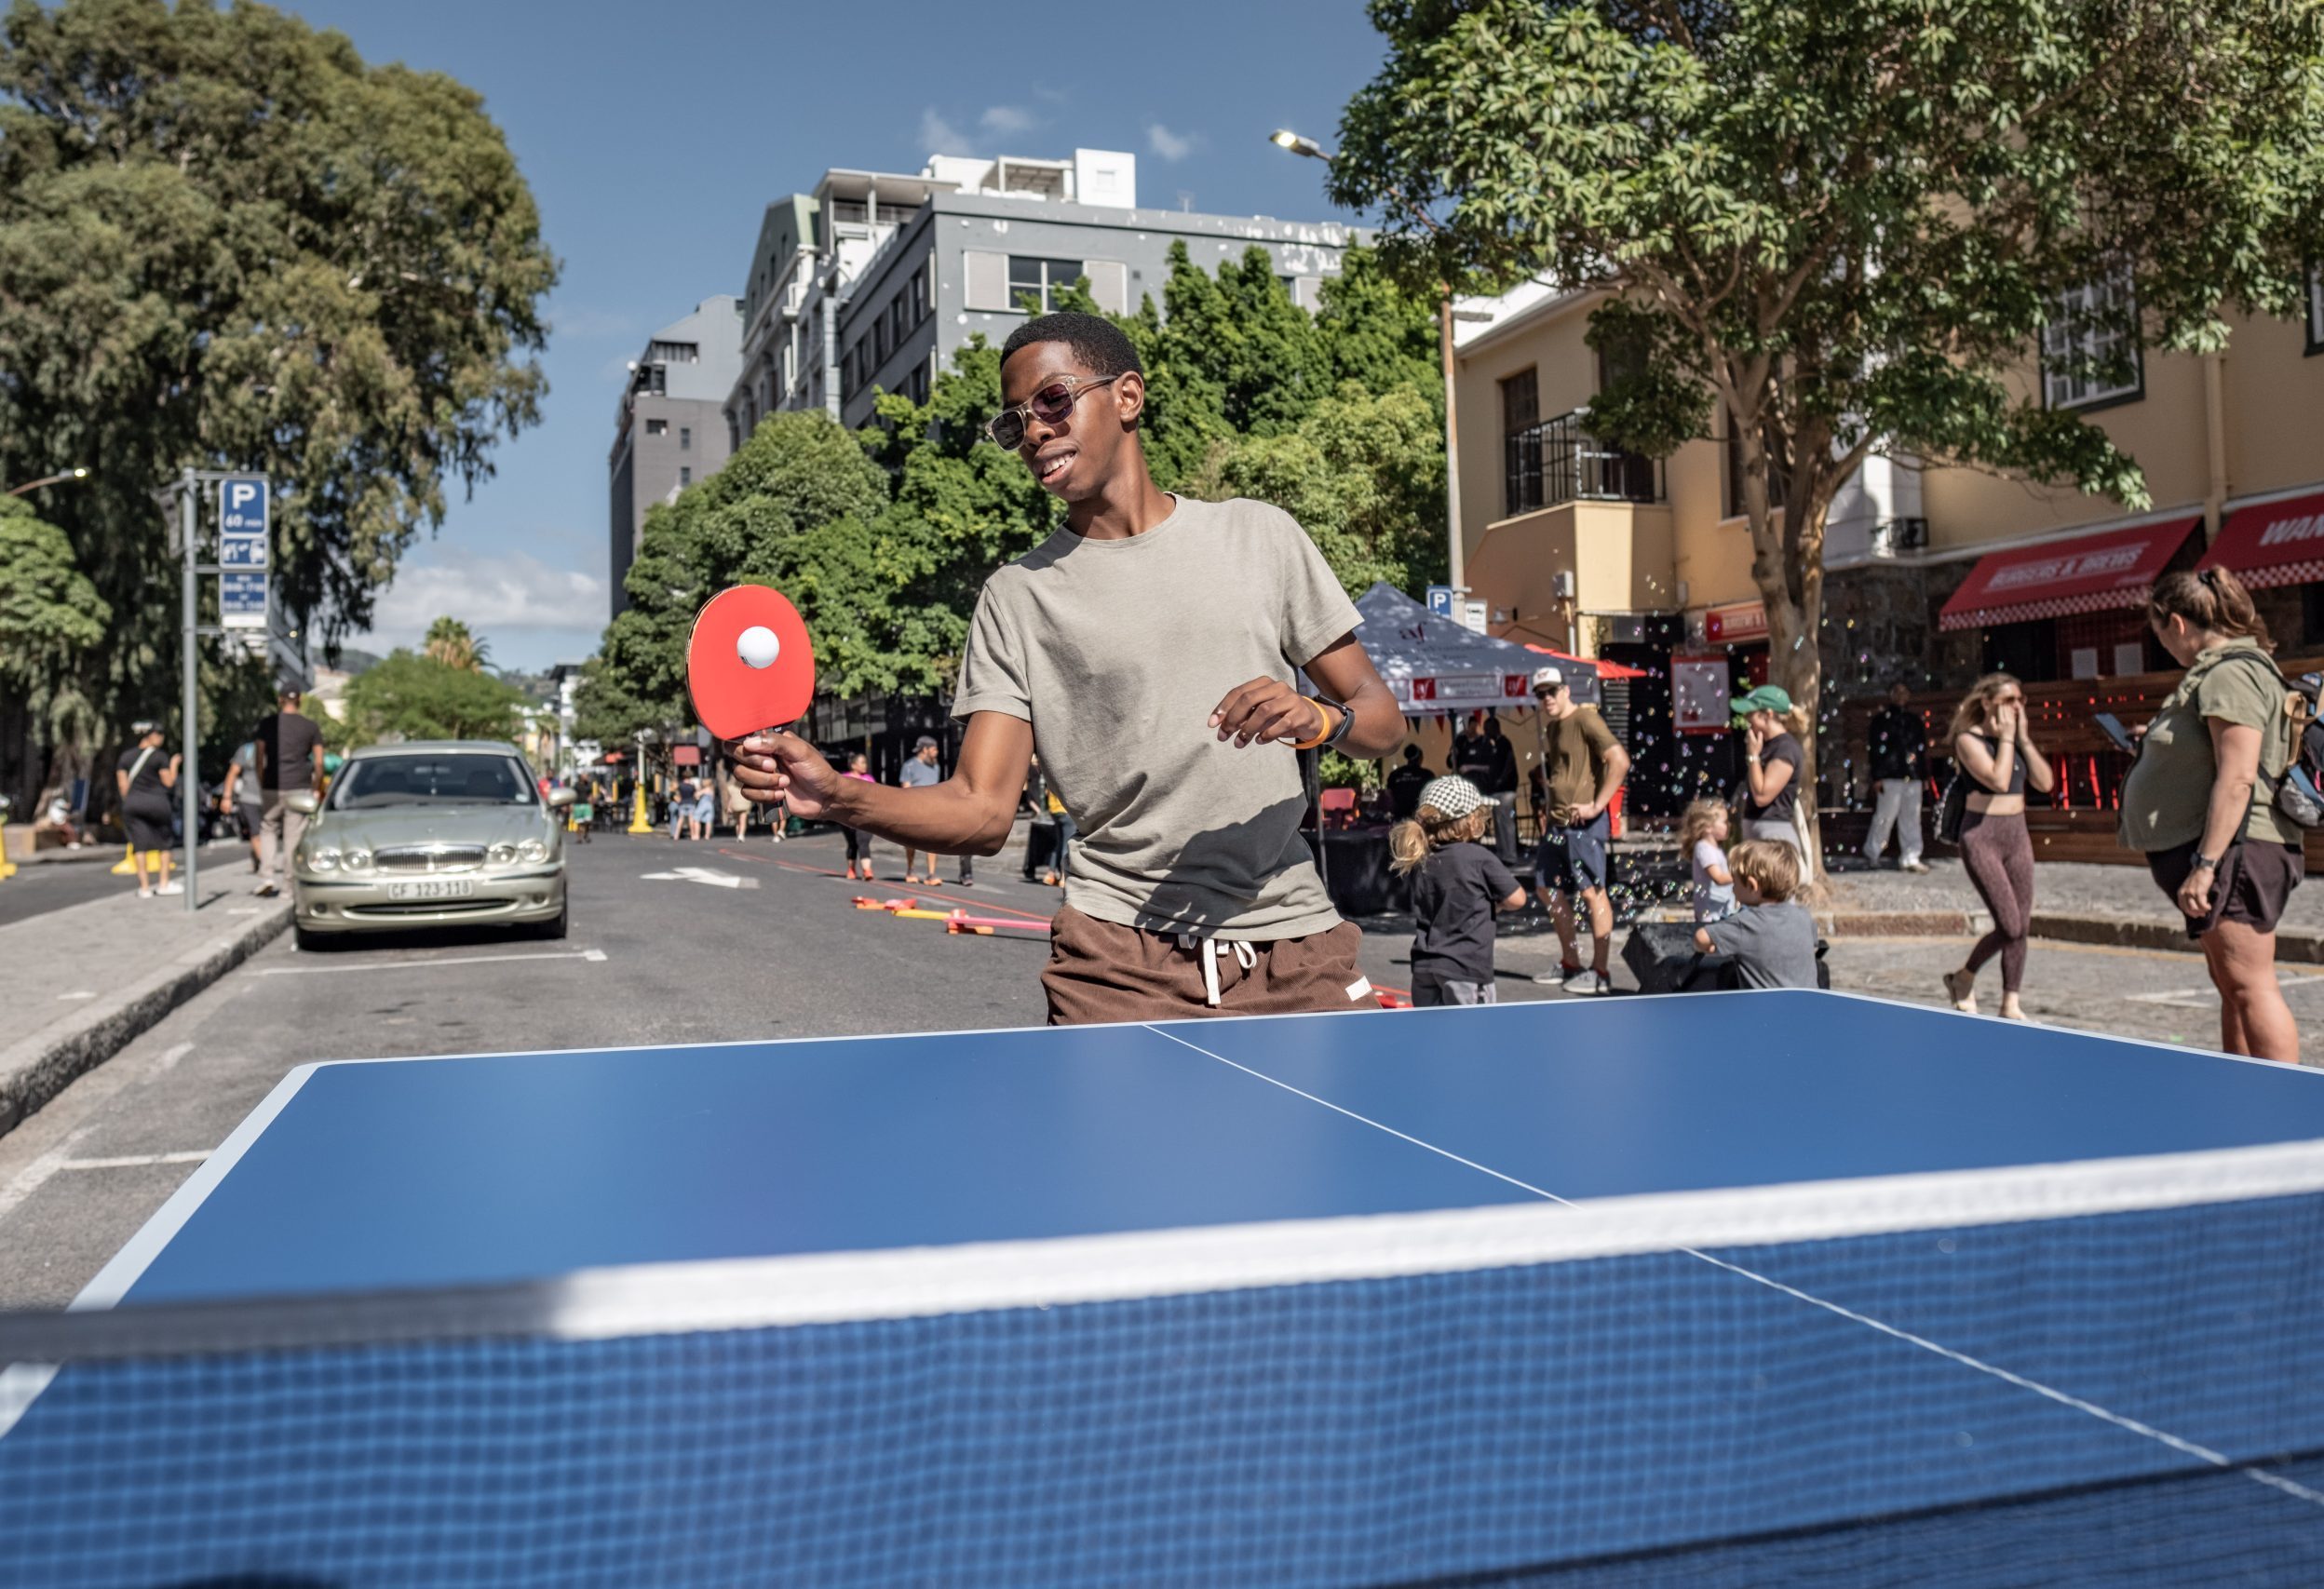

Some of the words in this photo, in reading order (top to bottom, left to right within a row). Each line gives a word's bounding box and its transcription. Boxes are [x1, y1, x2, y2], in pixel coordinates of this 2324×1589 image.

[232, 483, 256, 509] P
[225, 514, 243, 528] 60
[1434, 593, 1447, 609] P
